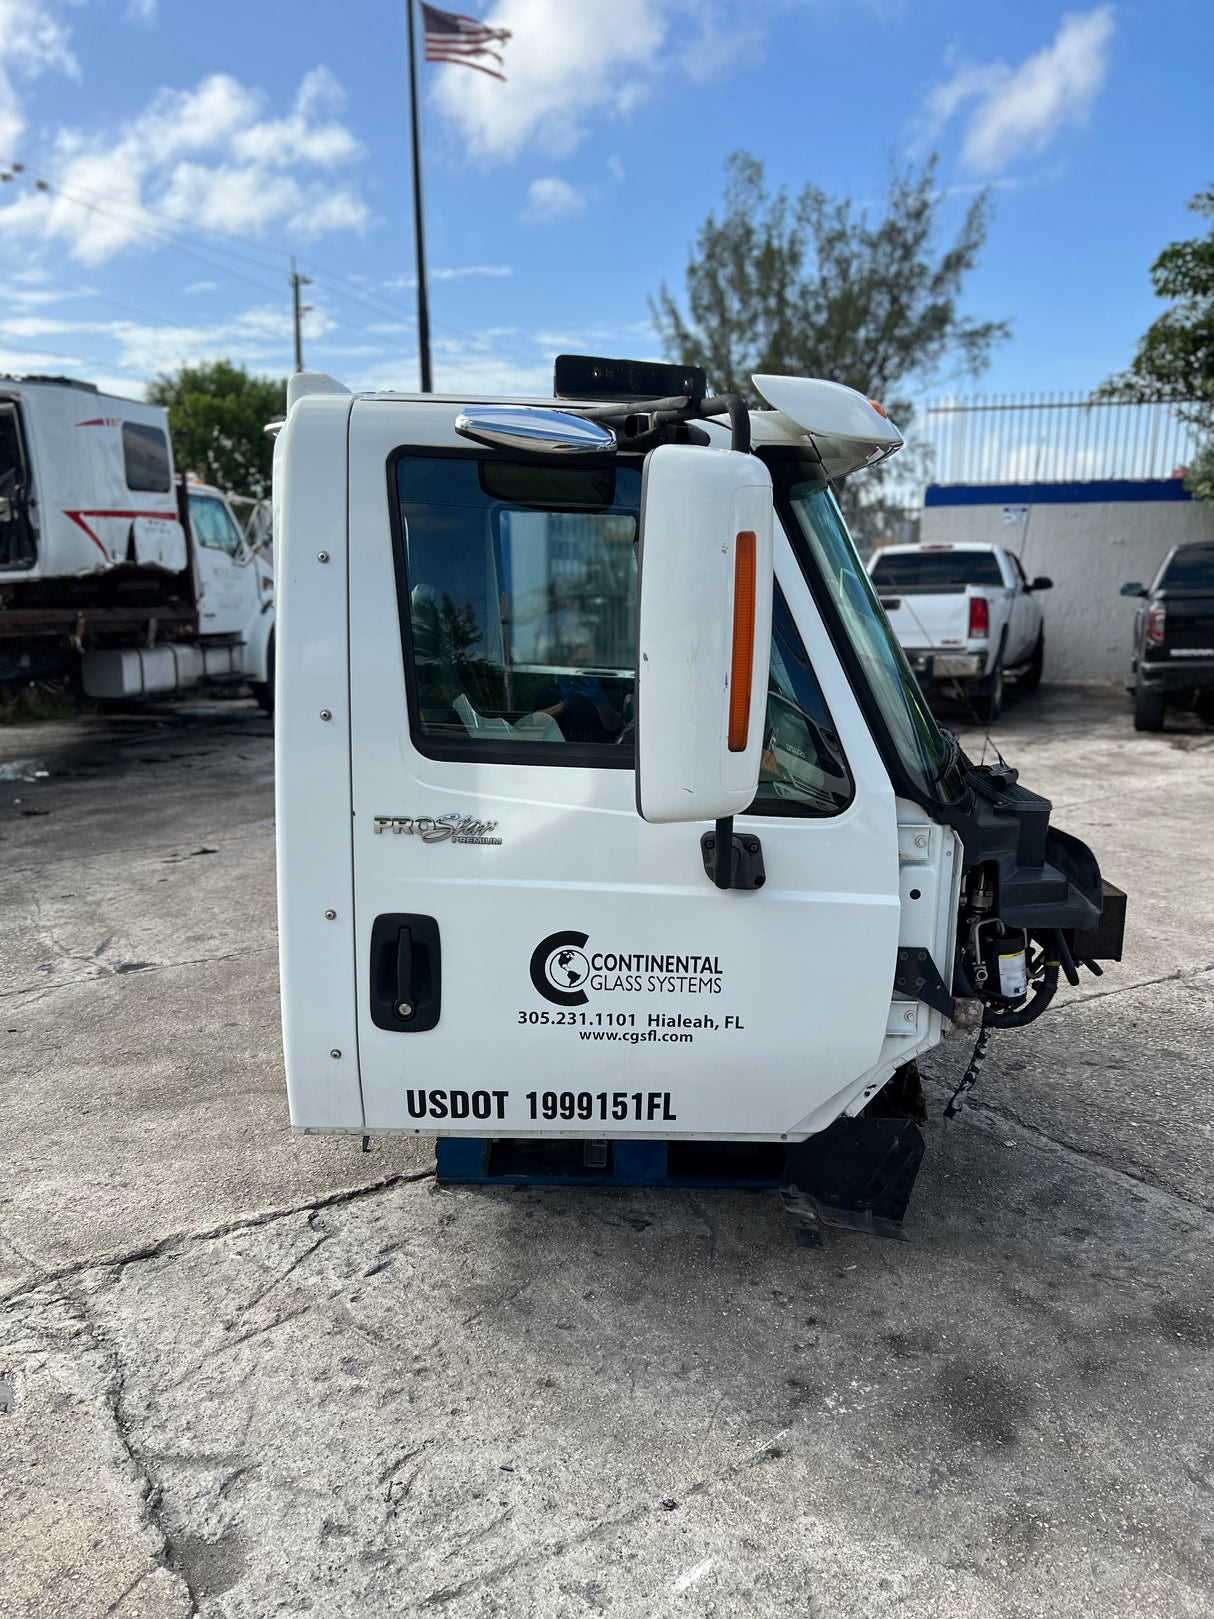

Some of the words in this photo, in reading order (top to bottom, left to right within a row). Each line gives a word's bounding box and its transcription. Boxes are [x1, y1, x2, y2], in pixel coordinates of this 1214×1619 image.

[451, 835, 503, 846] PREMIUM
[590, 953, 723, 975] CONTINENTAL
[590, 974, 642, 992] GLASS
[647, 976, 722, 994] SYSTEMS
[517, 1011, 636, 1027] 305.231.1101
[647, 1014, 720, 1031] Hialeah,
[724, 1016, 745, 1030] FL
[579, 1030, 693, 1044] www.cgsfl.com
[406, 1090, 510, 1120] USDOT
[525, 1091, 677, 1121] 1999151FL
